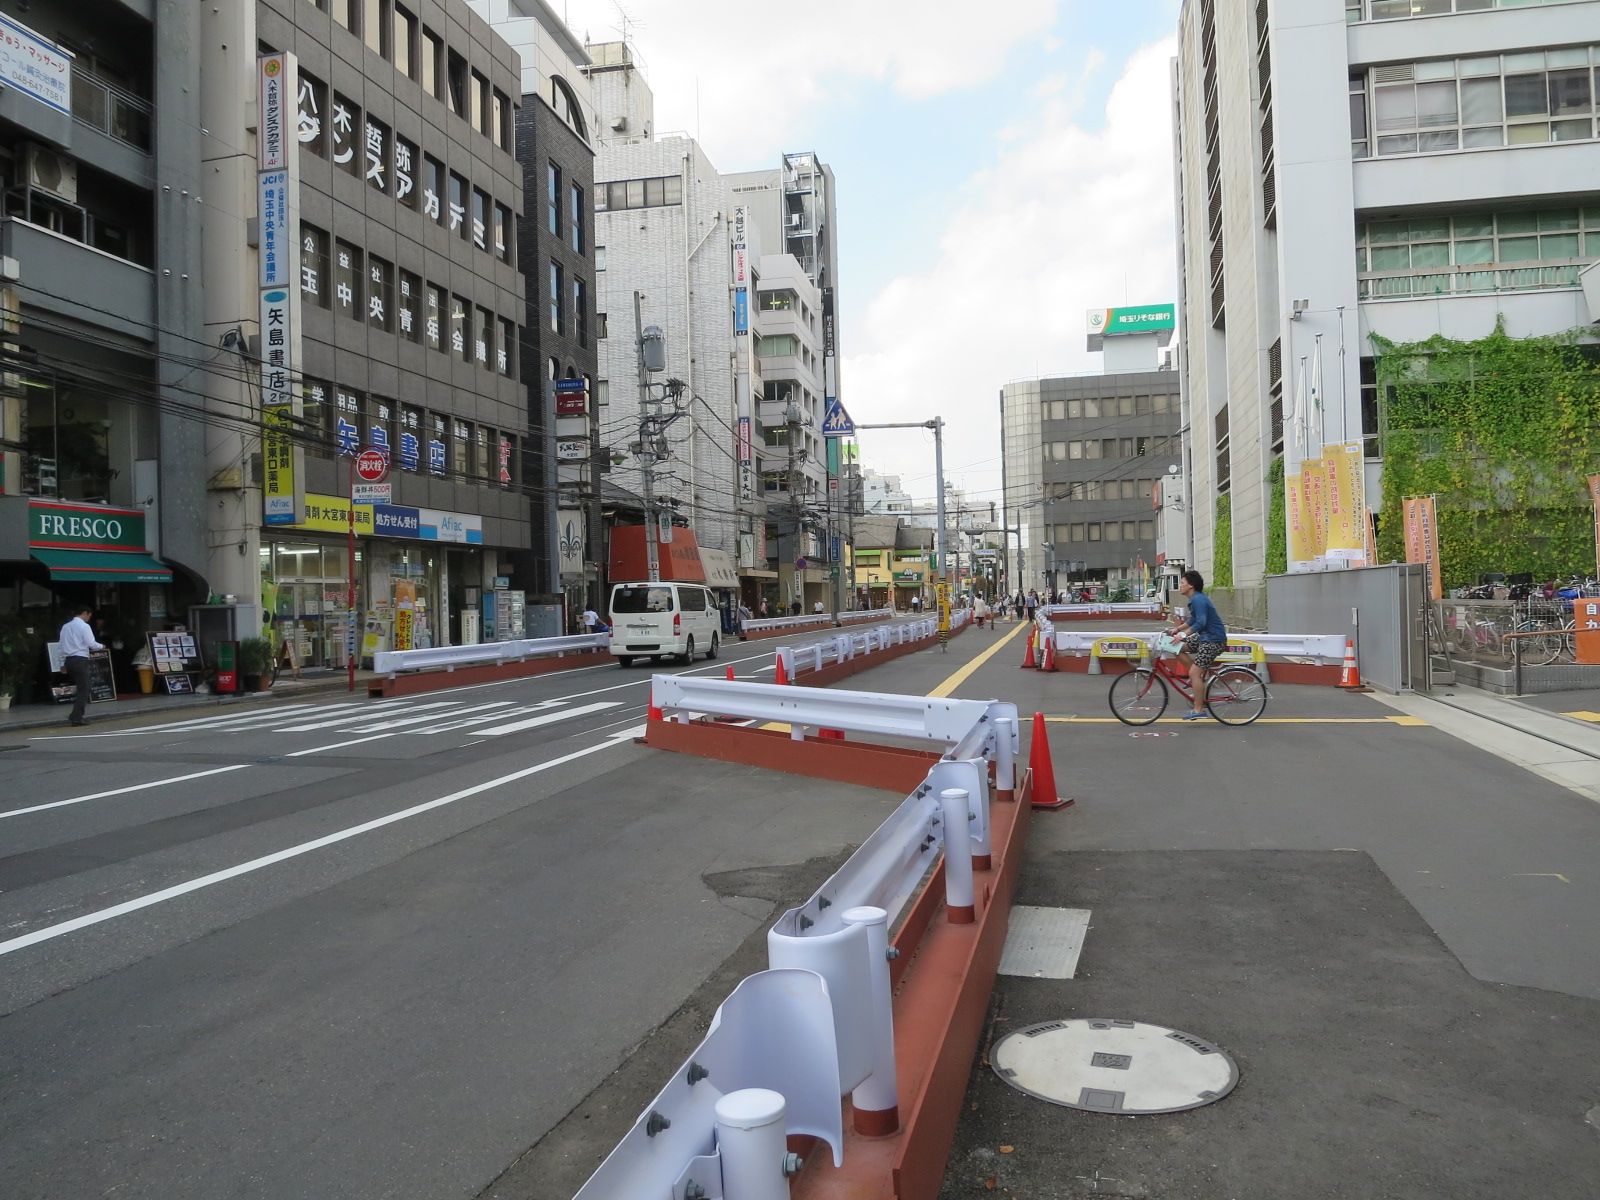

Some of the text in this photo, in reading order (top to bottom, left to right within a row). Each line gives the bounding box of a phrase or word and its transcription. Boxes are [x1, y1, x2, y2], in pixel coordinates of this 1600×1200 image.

[263, 175, 278, 185] JCI
[265, 189, 276, 283] 埼玉中央青年会議所
[1119, 313, 1170, 323] 埼玉りそな銀行
[268, 308, 285, 389] 矢島書店
[359, 460, 383, 471] 消火栓
[322, 507, 371, 525] 大宮東薬局
[376, 513, 417, 529] 処方せん受付
[39, 514, 122, 540] FRESCO
